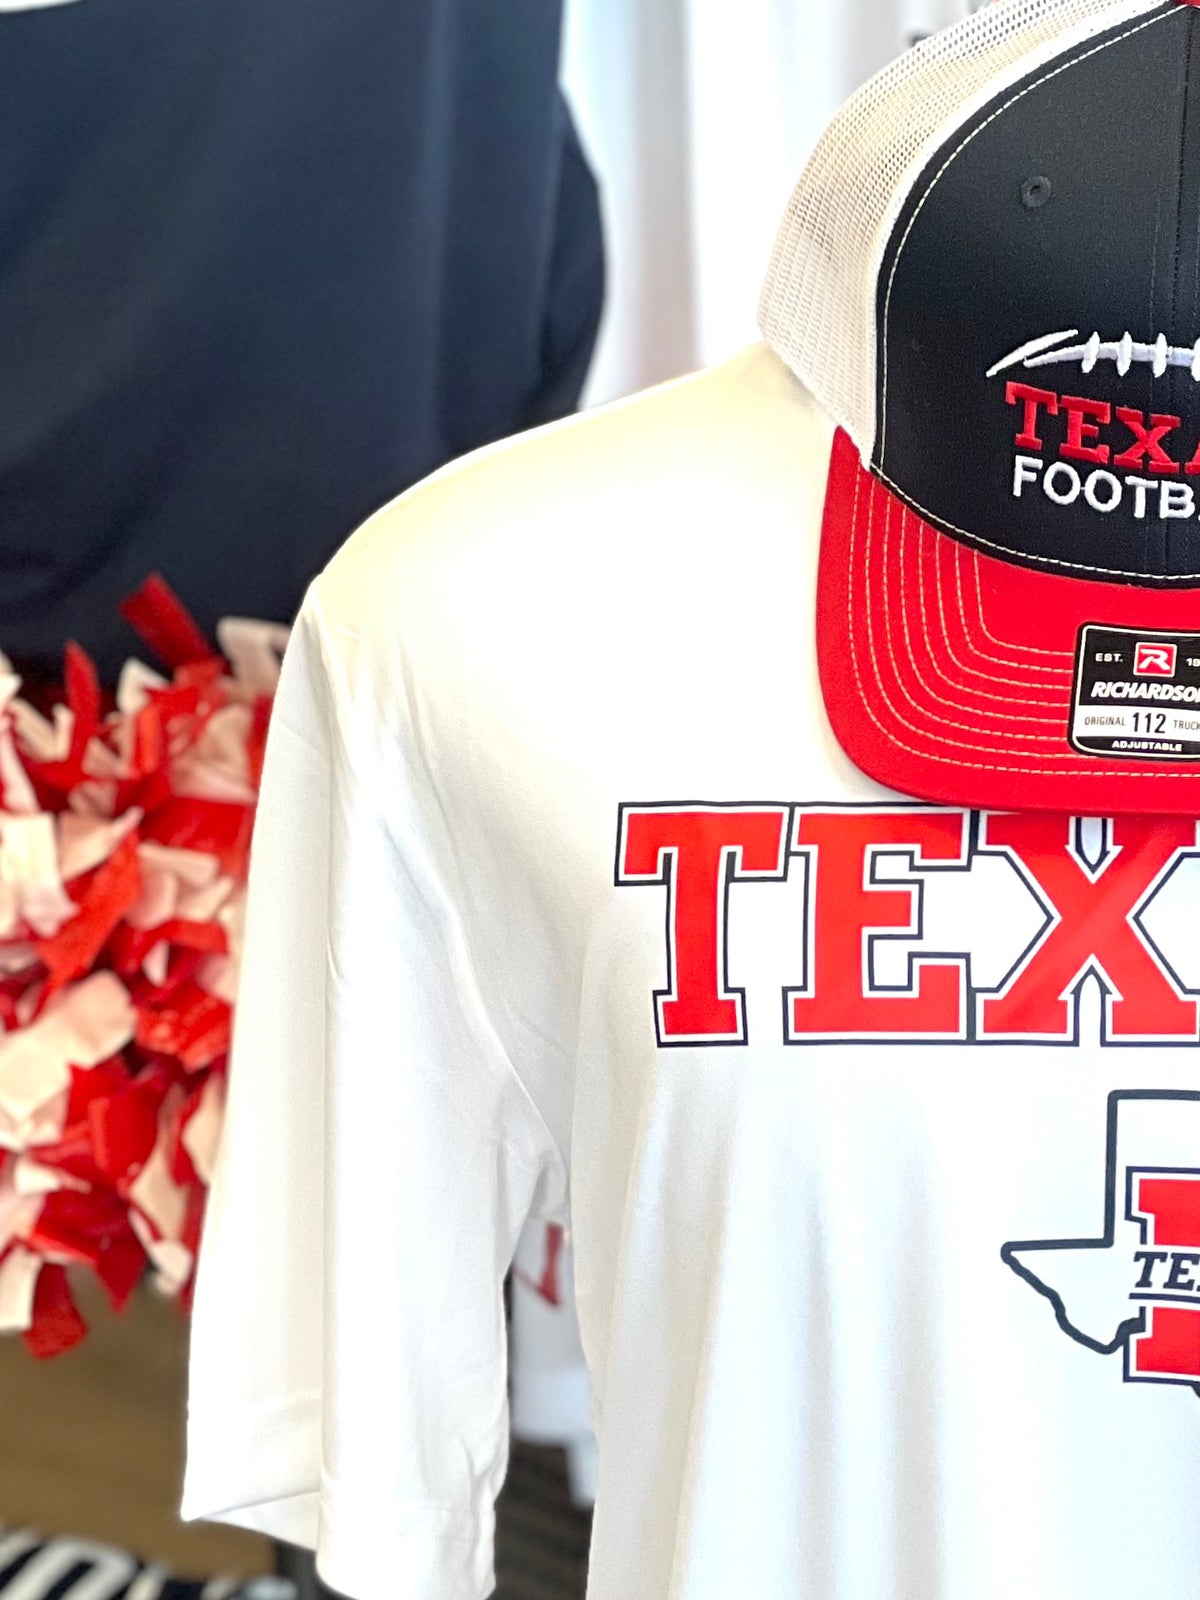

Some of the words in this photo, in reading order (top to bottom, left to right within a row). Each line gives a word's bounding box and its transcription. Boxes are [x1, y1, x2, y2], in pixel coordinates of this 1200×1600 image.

[1095, 652, 1123, 663] EST.
[1084, 716, 1126, 727] ORIGINAL
[1132, 711, 1167, 734] 112
[1112, 740, 1183, 752] ADJUSTABLE
